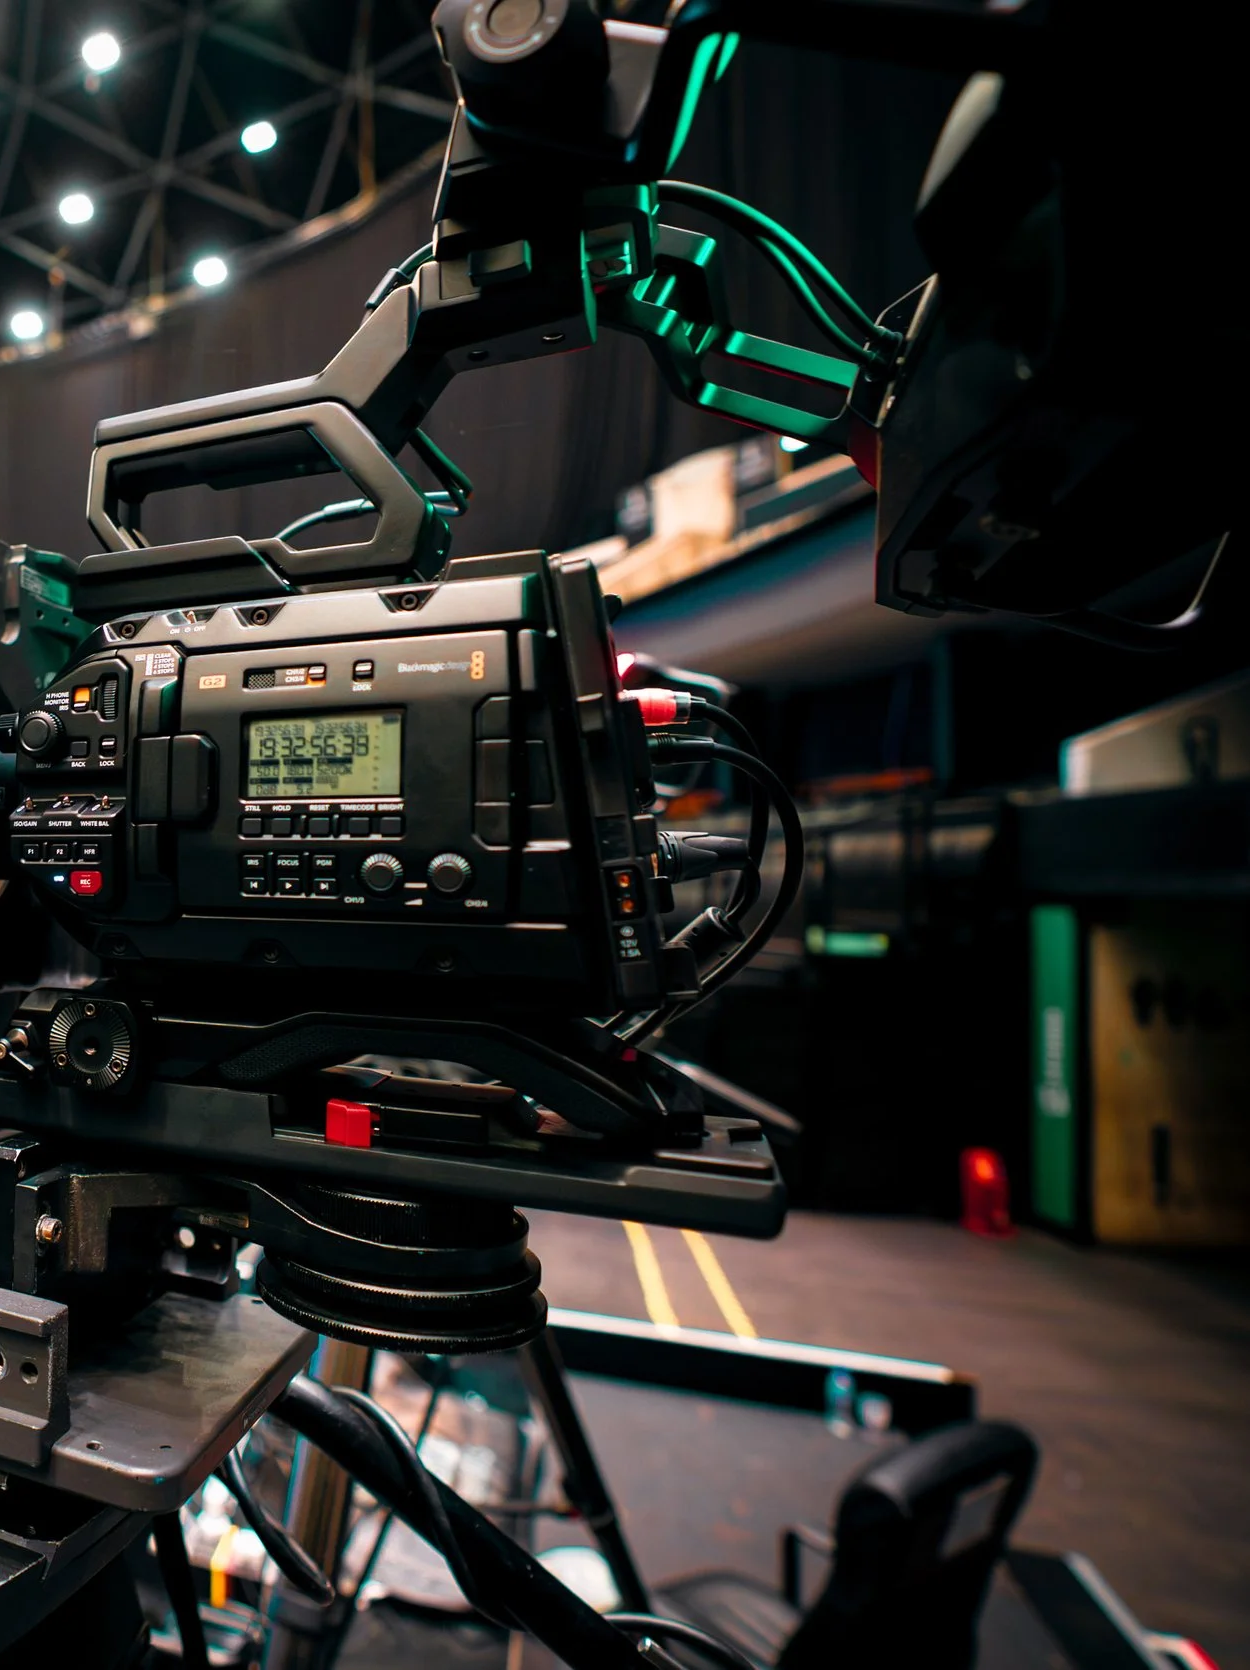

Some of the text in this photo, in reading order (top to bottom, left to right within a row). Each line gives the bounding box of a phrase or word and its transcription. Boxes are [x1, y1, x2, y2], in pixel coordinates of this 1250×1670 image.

[202, 677, 223, 686] G2
[51, 691, 69, 699] PHONE
[44, 698, 69, 706] MONITOR
[7, 728, 12, 737] 1
[377, 803, 404, 811] BRIGHT
